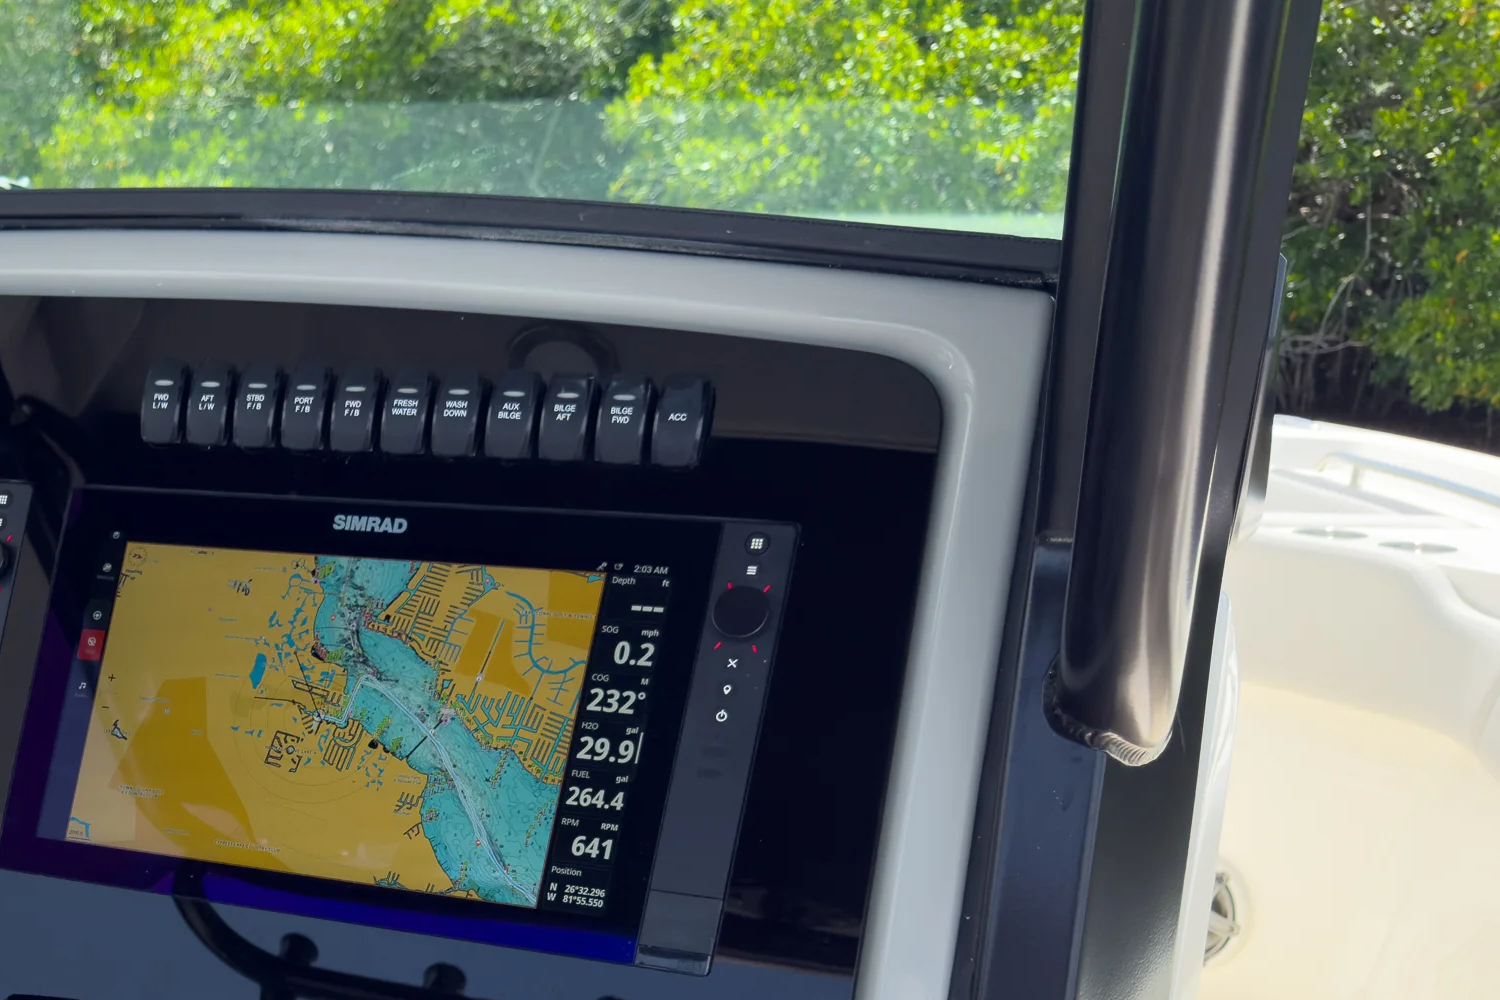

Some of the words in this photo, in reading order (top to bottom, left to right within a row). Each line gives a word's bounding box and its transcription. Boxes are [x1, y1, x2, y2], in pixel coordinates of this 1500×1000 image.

[154, 393, 169, 401] FWD
[345, 400, 362, 408] FWD
[393, 399, 419, 408] FRESH
[445, 401, 468, 409] WASH
[502, 403, 520, 411] AUX
[554, 404, 576, 413] BILGE
[392, 408, 417, 416] WATER
[443, 409, 467, 418] DOWN
[498, 411, 522, 420] BILGE
[611, 407, 633, 415] BILGE
[555, 413, 572, 421] AFT
[611, 415, 630, 424] FWD
[668, 413, 687, 422] ACC
[333, 515, 408, 534] SIMRAD
[633, 565, 652, 574] 2:03
[653, 566, 669, 575] AM
[612, 576, 636, 586] Depth
[662, 579, 670, 587] ft
[602, 625, 619, 634] SOG
[641, 629, 659, 638] mph
[614, 641, 655, 667] 0.2
[592, 673, 609, 682] COG
[586, 688, 646, 715] 232°
[581, 722, 599, 731] H2O
[626, 727, 639, 735] gal
[576, 736, 635, 764] 29.9
[571, 770, 590, 779] FUEL
[616, 775, 629, 784] gal
[565, 786, 624, 811] 264.4
[561, 818, 580, 827] RPM
[601, 822, 619, 832] RPM
[571, 835, 614, 860] 641
[551, 865, 582, 877] Position
[549, 882, 557, 891] N
[564, 884, 605, 898] 26°32.296
[547, 892, 557, 901] W
[562, 895, 603, 908] 81°55.550
